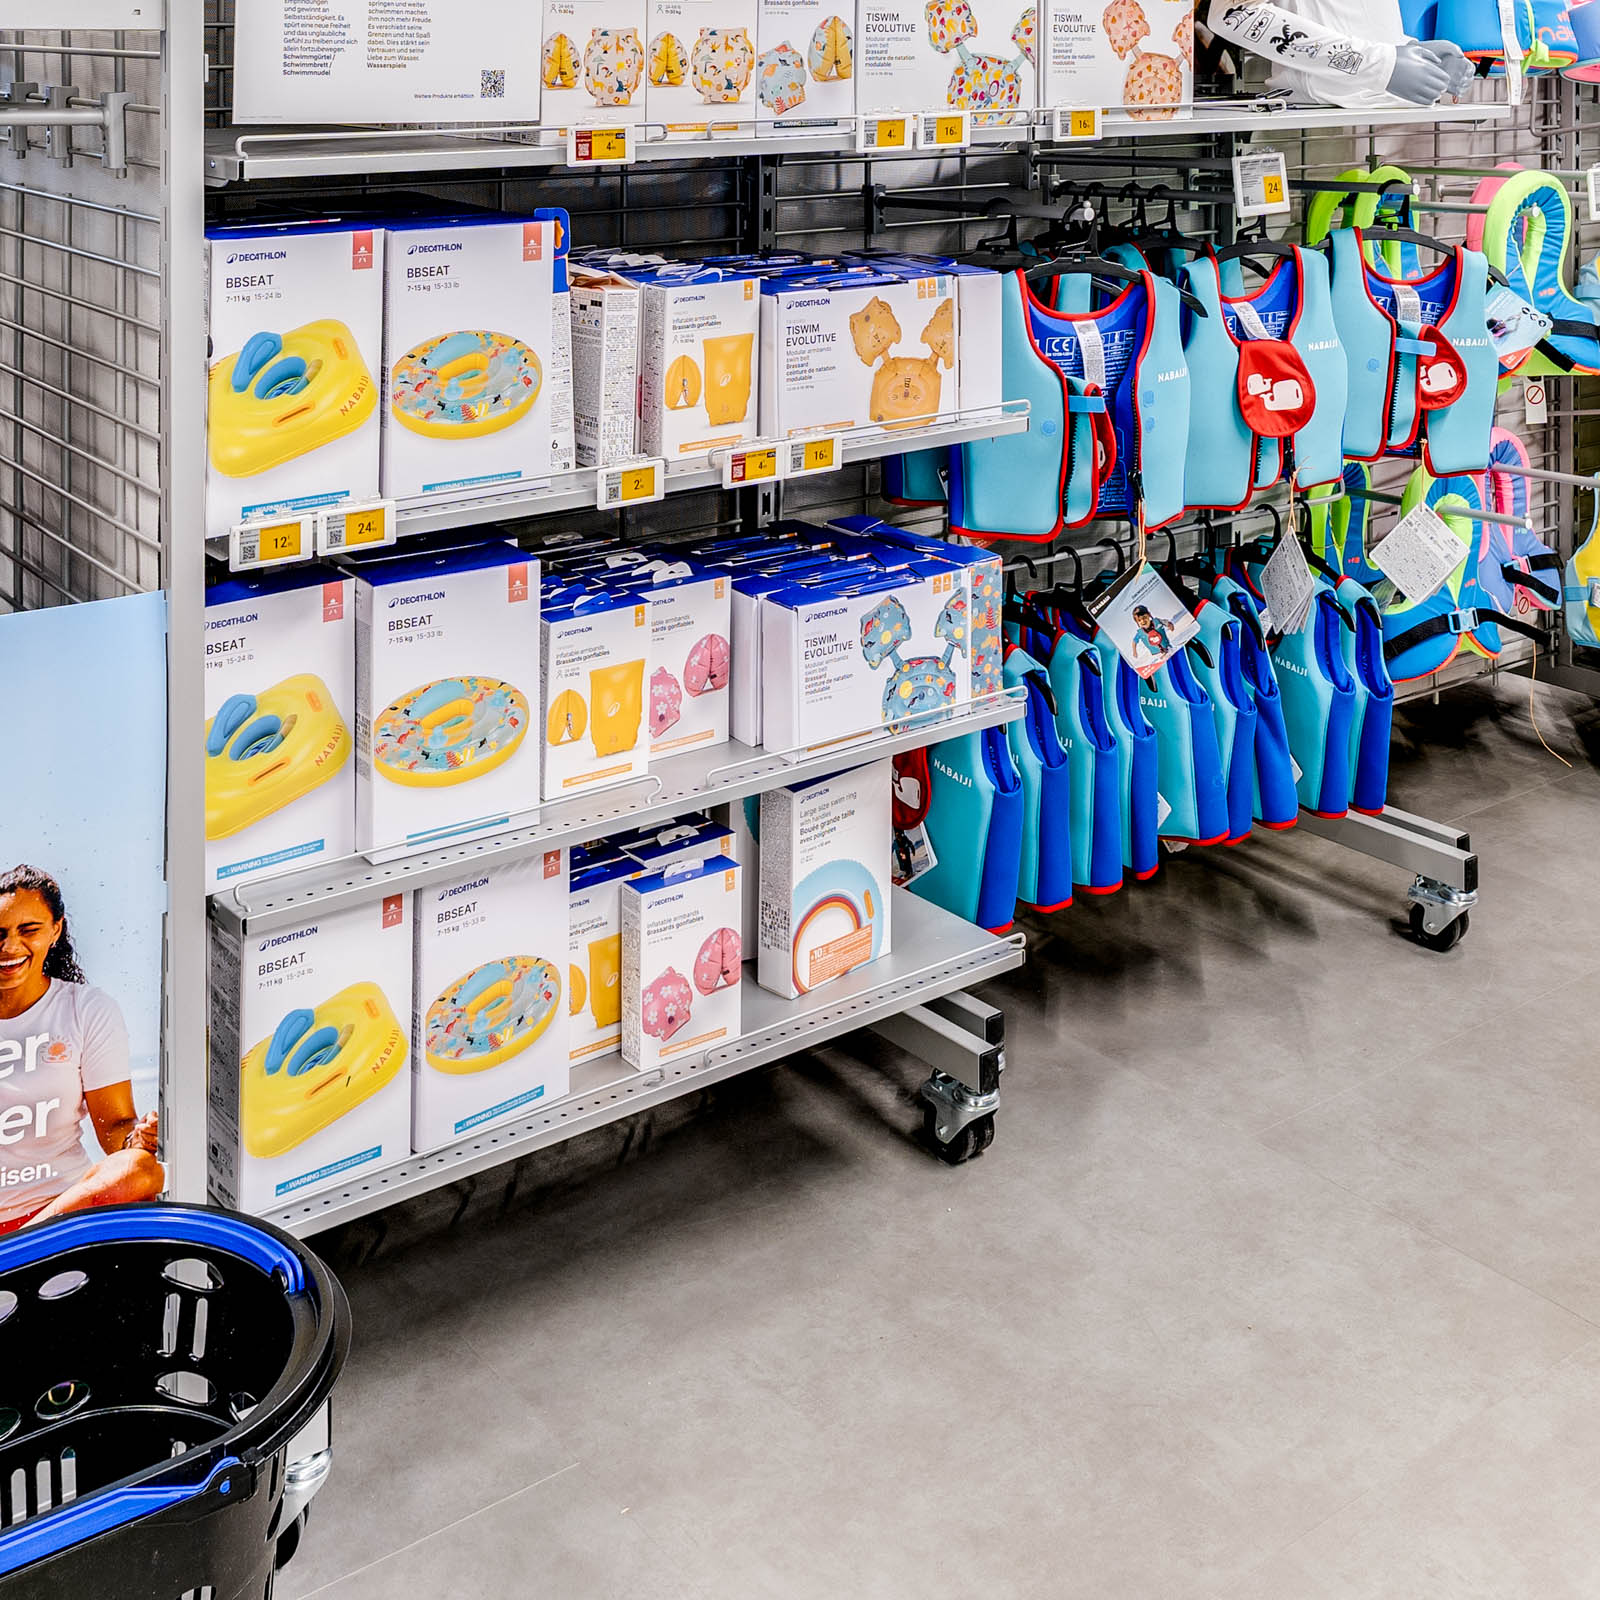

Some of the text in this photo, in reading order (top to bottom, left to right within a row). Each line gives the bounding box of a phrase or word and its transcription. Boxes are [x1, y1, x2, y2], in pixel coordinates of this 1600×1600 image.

[866, 12, 900, 22] TISWIM
[1053, 14, 1082, 22] TISWIM
[865, 24, 916, 33] EVOLUTIVE
[1053, 25, 1096, 33] EVOLUTIVE
[418, 242, 463, 254] DECATHLON
[238, 251, 287, 262] DECATHLON
[407, 265, 451, 278] BBSEAT
[225, 274, 275, 289] BBSEAT
[422, 283, 431, 292] kg
[240, 294, 251, 303] kg
[795, 298, 831, 308] DECATHLON
[786, 324, 820, 336] TISWIM
[786, 333, 837, 347] EVOLUTIVE
[1307, 339, 1338, 353] NABAIJI
[1452, 336, 1489, 348] NABAIJI
[1157, 366, 1187, 385] NABAIJI
[339, 373, 369, 417] NABAIJI
[400, 591, 446, 606] DECATHLON
[813, 607, 848, 620] DECATHLON
[210, 613, 259, 629] DECATHLON
[388, 614, 434, 631] BBSEAT
[205, 637, 247, 655] BSEAT
[804, 633, 837, 648] TISWIM
[805, 640, 853, 660] EVOLUTIVE
[1275, 655, 1308, 677] NABAIJI
[934, 758, 973, 789] NABAIJI
[448, 877, 489, 897] DECATHLON
[437, 902, 478, 924] BBSEAT
[271, 926, 318, 947] DECATHLON
[258, 951, 306, 976] BBSEAT
